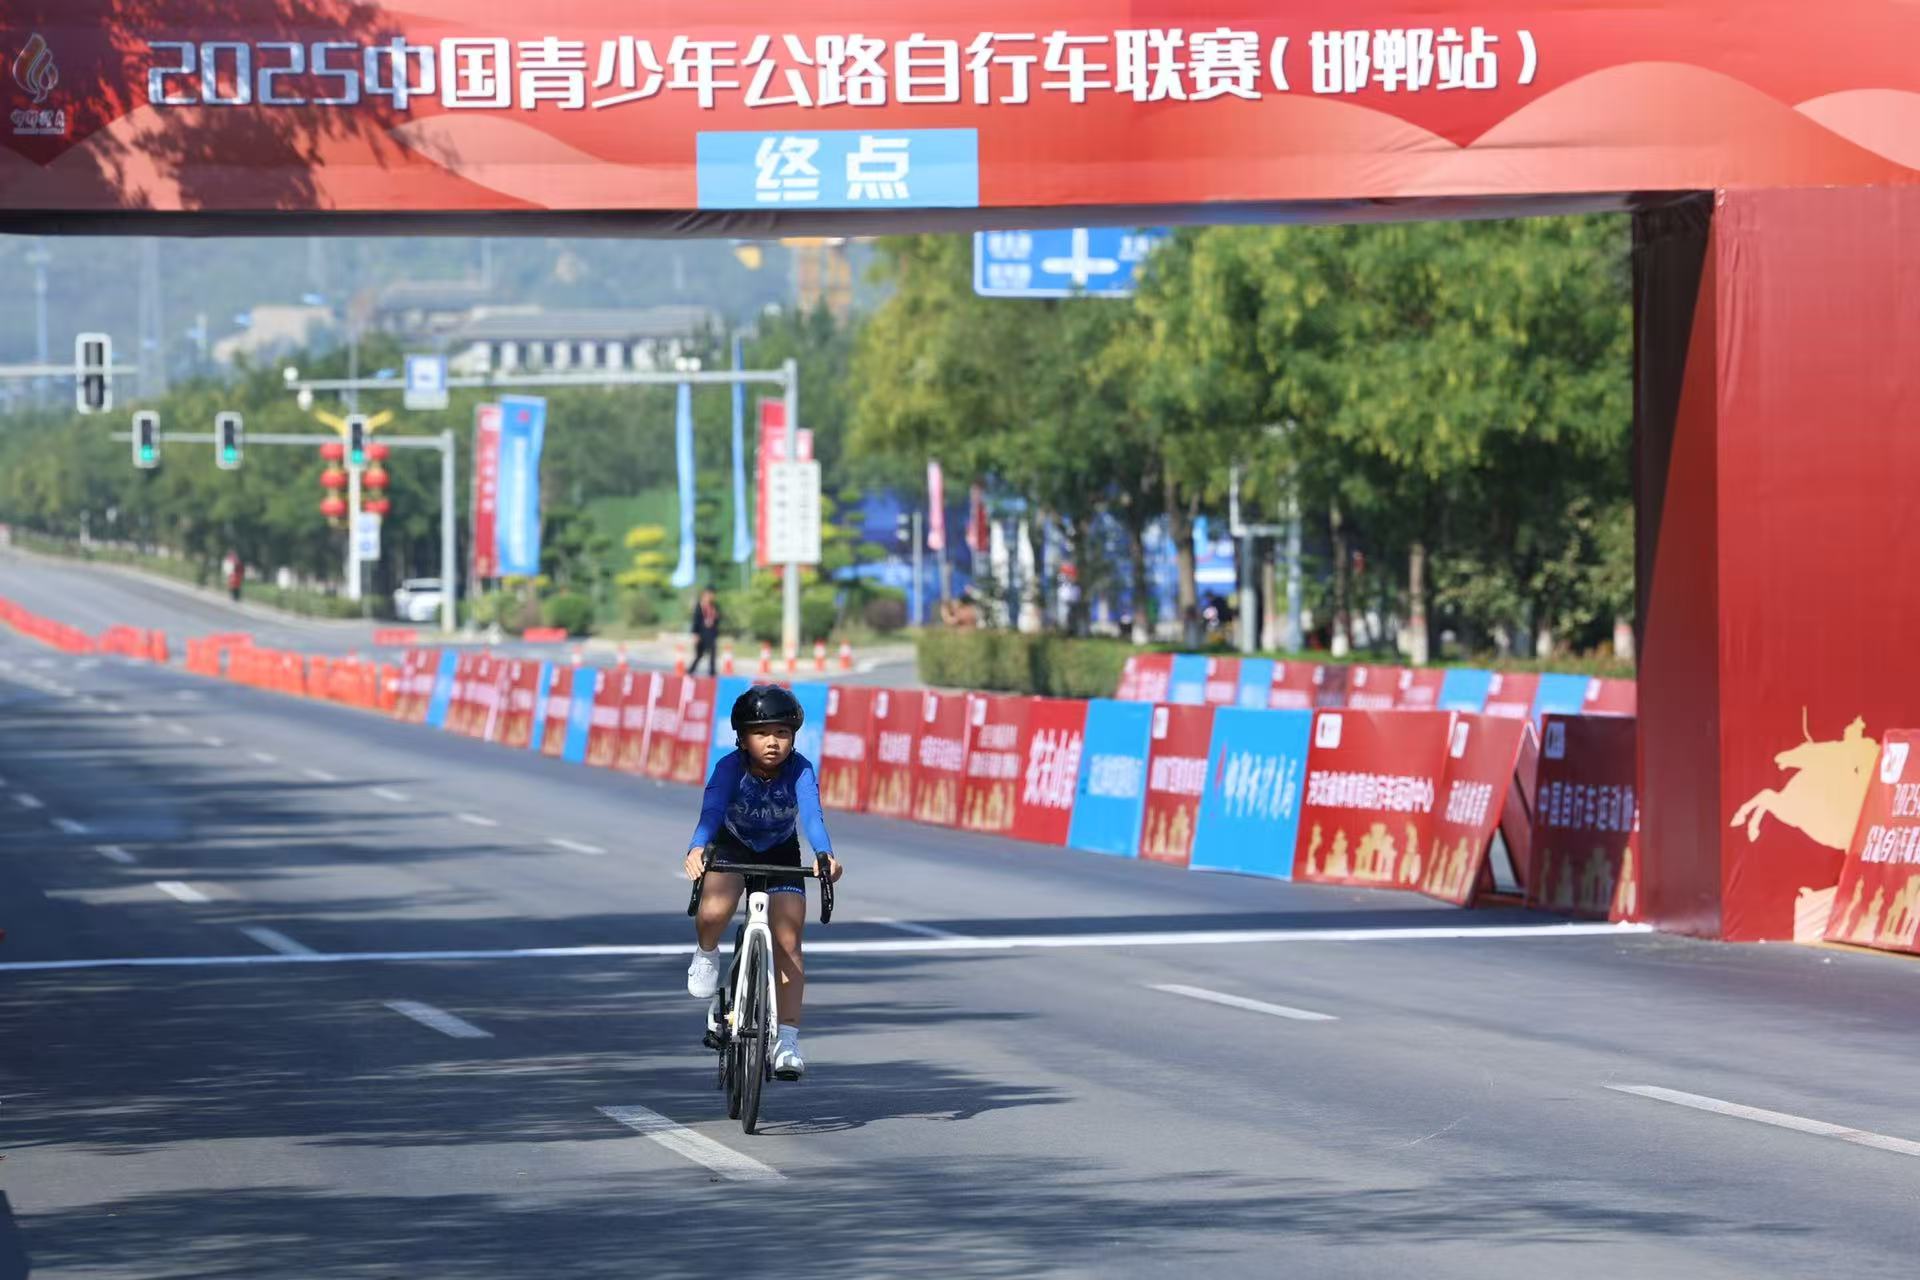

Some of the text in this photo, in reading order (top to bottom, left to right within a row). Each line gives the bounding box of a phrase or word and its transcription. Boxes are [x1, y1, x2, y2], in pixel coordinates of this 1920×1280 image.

[147, 26, 1538, 112] 2025中国青少年公路自行车联赛（邯郸站）
[754, 135, 911, 203] 终点
